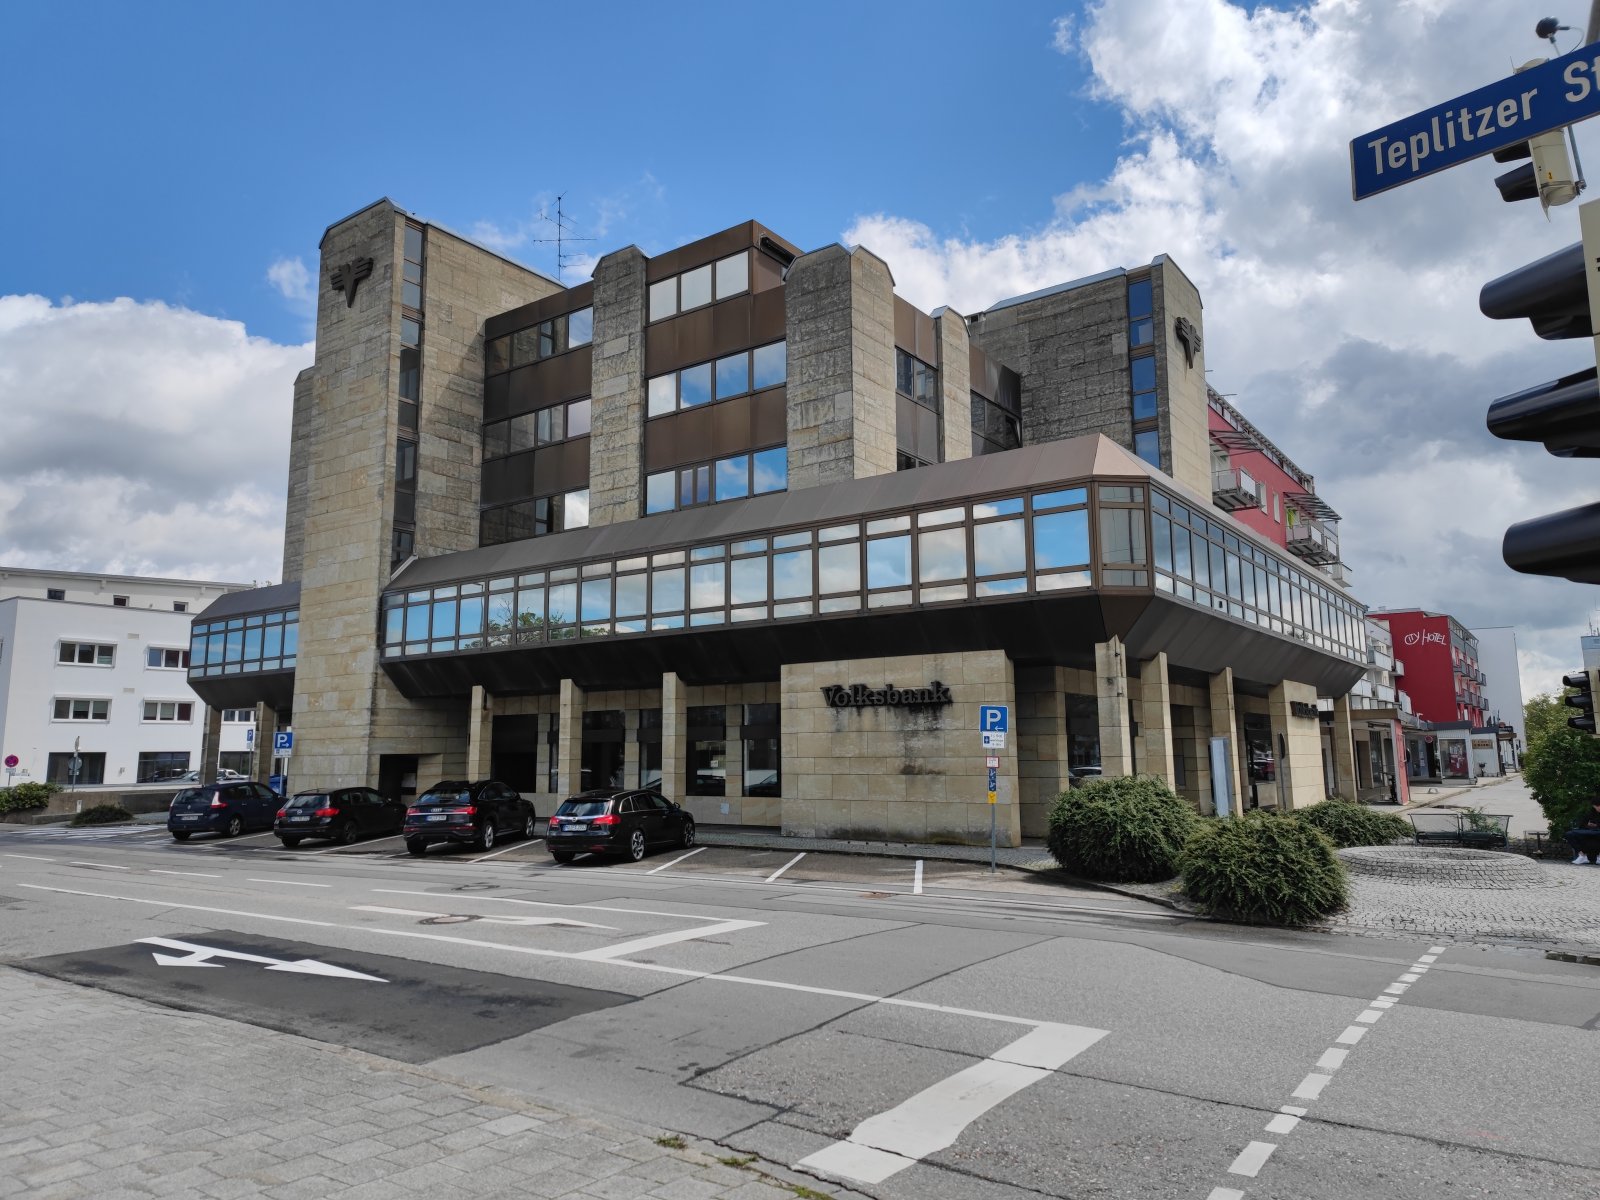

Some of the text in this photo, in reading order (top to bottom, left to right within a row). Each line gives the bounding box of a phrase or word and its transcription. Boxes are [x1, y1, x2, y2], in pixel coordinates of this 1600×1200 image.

[1368, 87, 1538, 175] Teplitzer
[1421, 629, 1447, 646] HOTEL
[820, 680, 950, 707] Volksbank
[986, 709, 1002, 730] P
[276, 734, 288, 748] P
